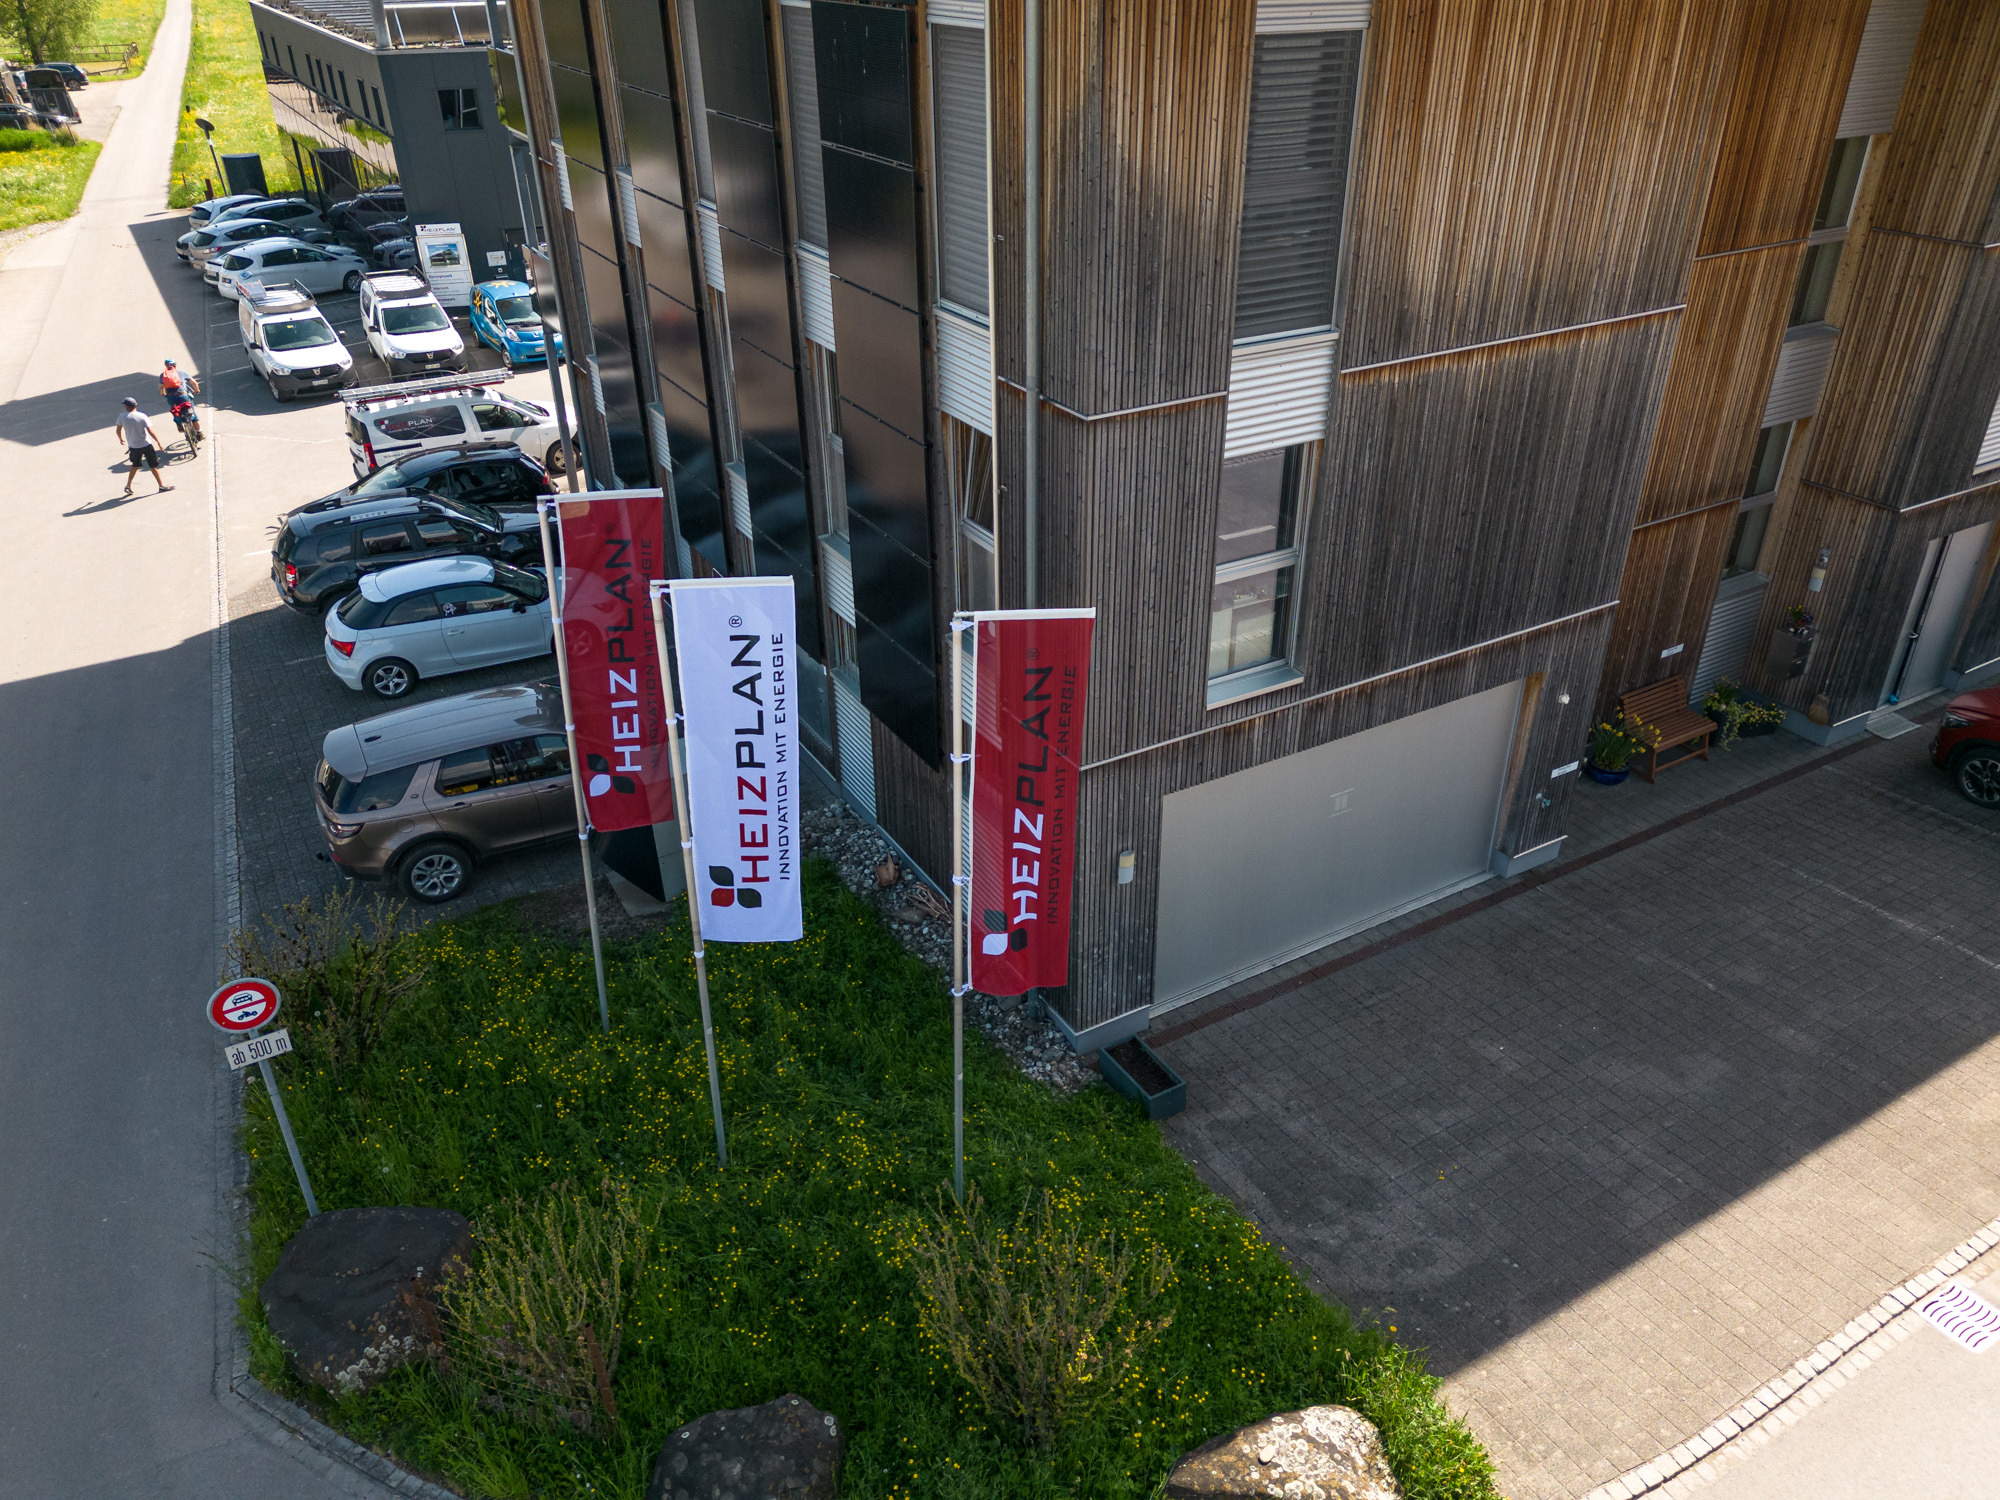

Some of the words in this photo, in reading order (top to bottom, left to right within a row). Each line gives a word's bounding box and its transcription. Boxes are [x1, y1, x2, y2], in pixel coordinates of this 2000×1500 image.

[641, 537, 654, 622] ENERGIE
[644, 629, 655, 657] MIT
[772, 633, 786, 724] ENERGIE
[775, 732, 787, 763] MIT
[1057, 666, 1077, 757] ENERGIE
[777, 770, 791, 880] INNOVATION
[1055, 766, 1067, 800] MIT
[1047, 807, 1063, 924] INNOVATION
[232, 1047, 246, 1066] ab
[247, 1038, 272, 1060] 500
[275, 1037, 288, 1051] m
